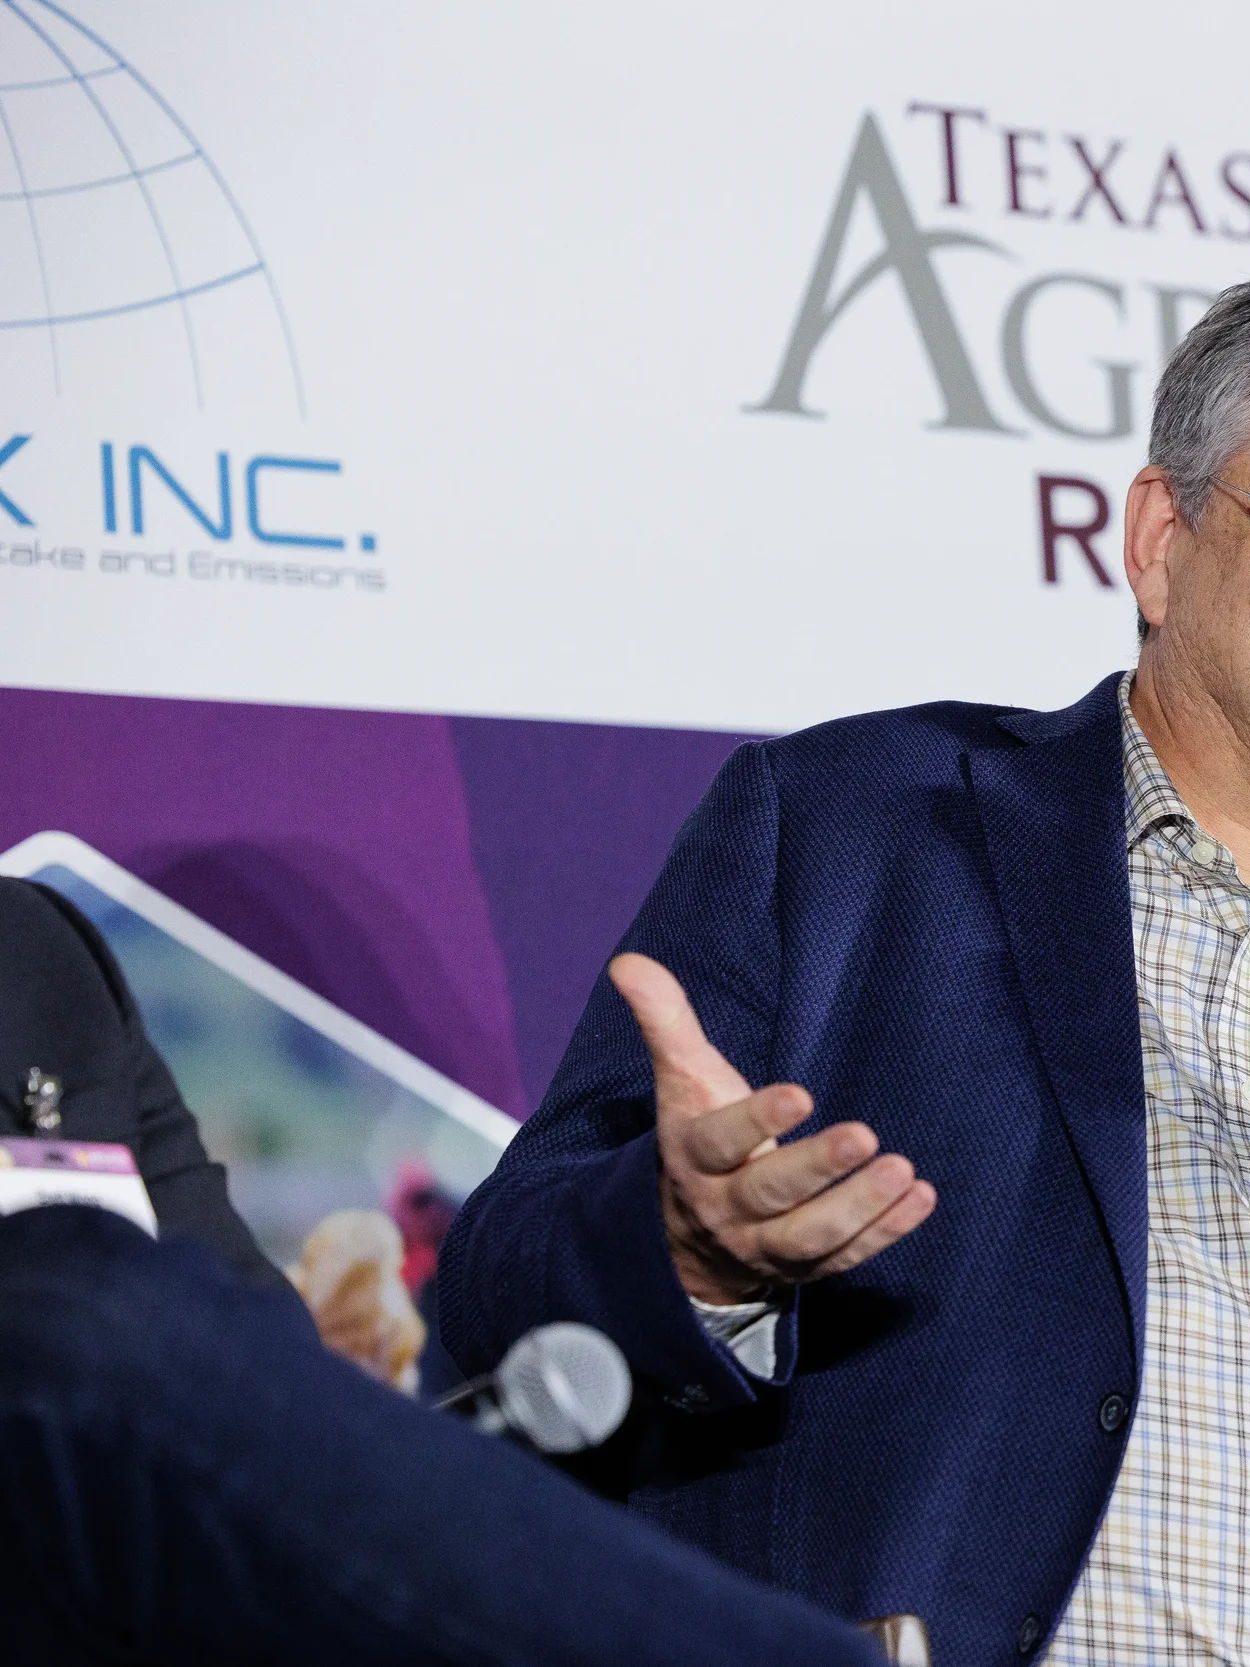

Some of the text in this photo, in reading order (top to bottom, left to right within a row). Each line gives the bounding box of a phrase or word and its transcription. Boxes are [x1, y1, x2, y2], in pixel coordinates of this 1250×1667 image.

[101, 441, 376, 552] INC.
[100, 546, 176, 578] and
[188, 551, 386, 592] Emissions
